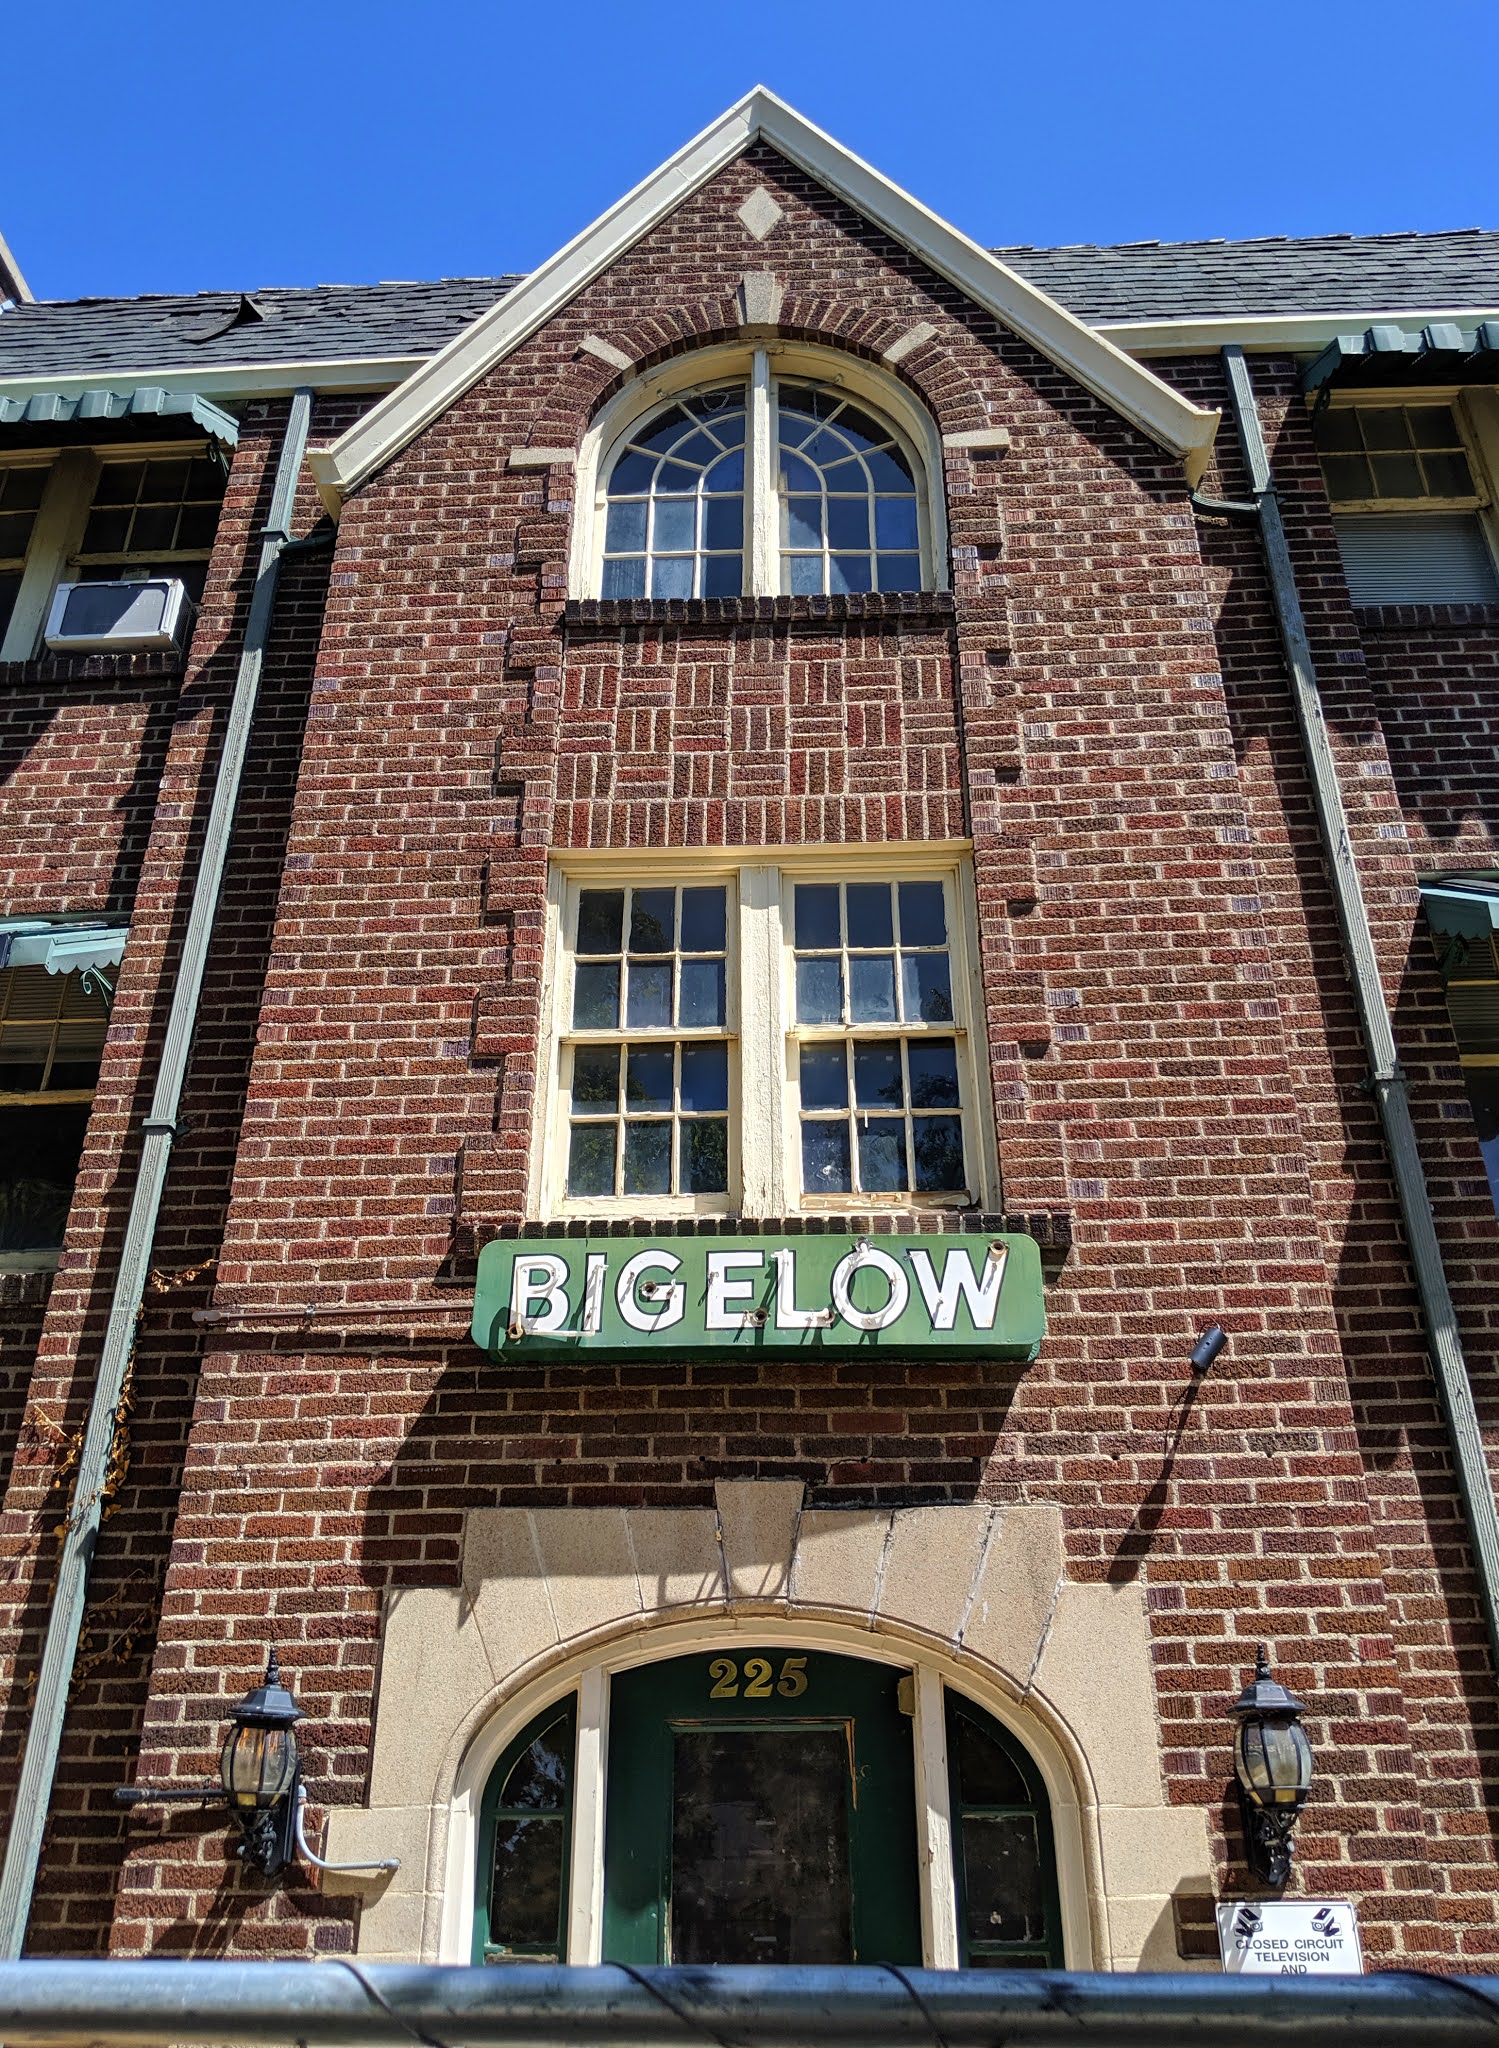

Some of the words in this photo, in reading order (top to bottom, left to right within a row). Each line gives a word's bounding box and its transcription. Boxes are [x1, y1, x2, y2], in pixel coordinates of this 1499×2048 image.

[509, 1247, 1009, 1333] BIGELOW
[709, 1657, 808, 1698] 225
[1235, 1939, 1289, 1950] CLOSED
[1294, 1939, 1344, 1949] CIRCUIT
[1254, 1952, 1330, 1962] TELEVISION
[1280, 1964, 1308, 1974] AND
